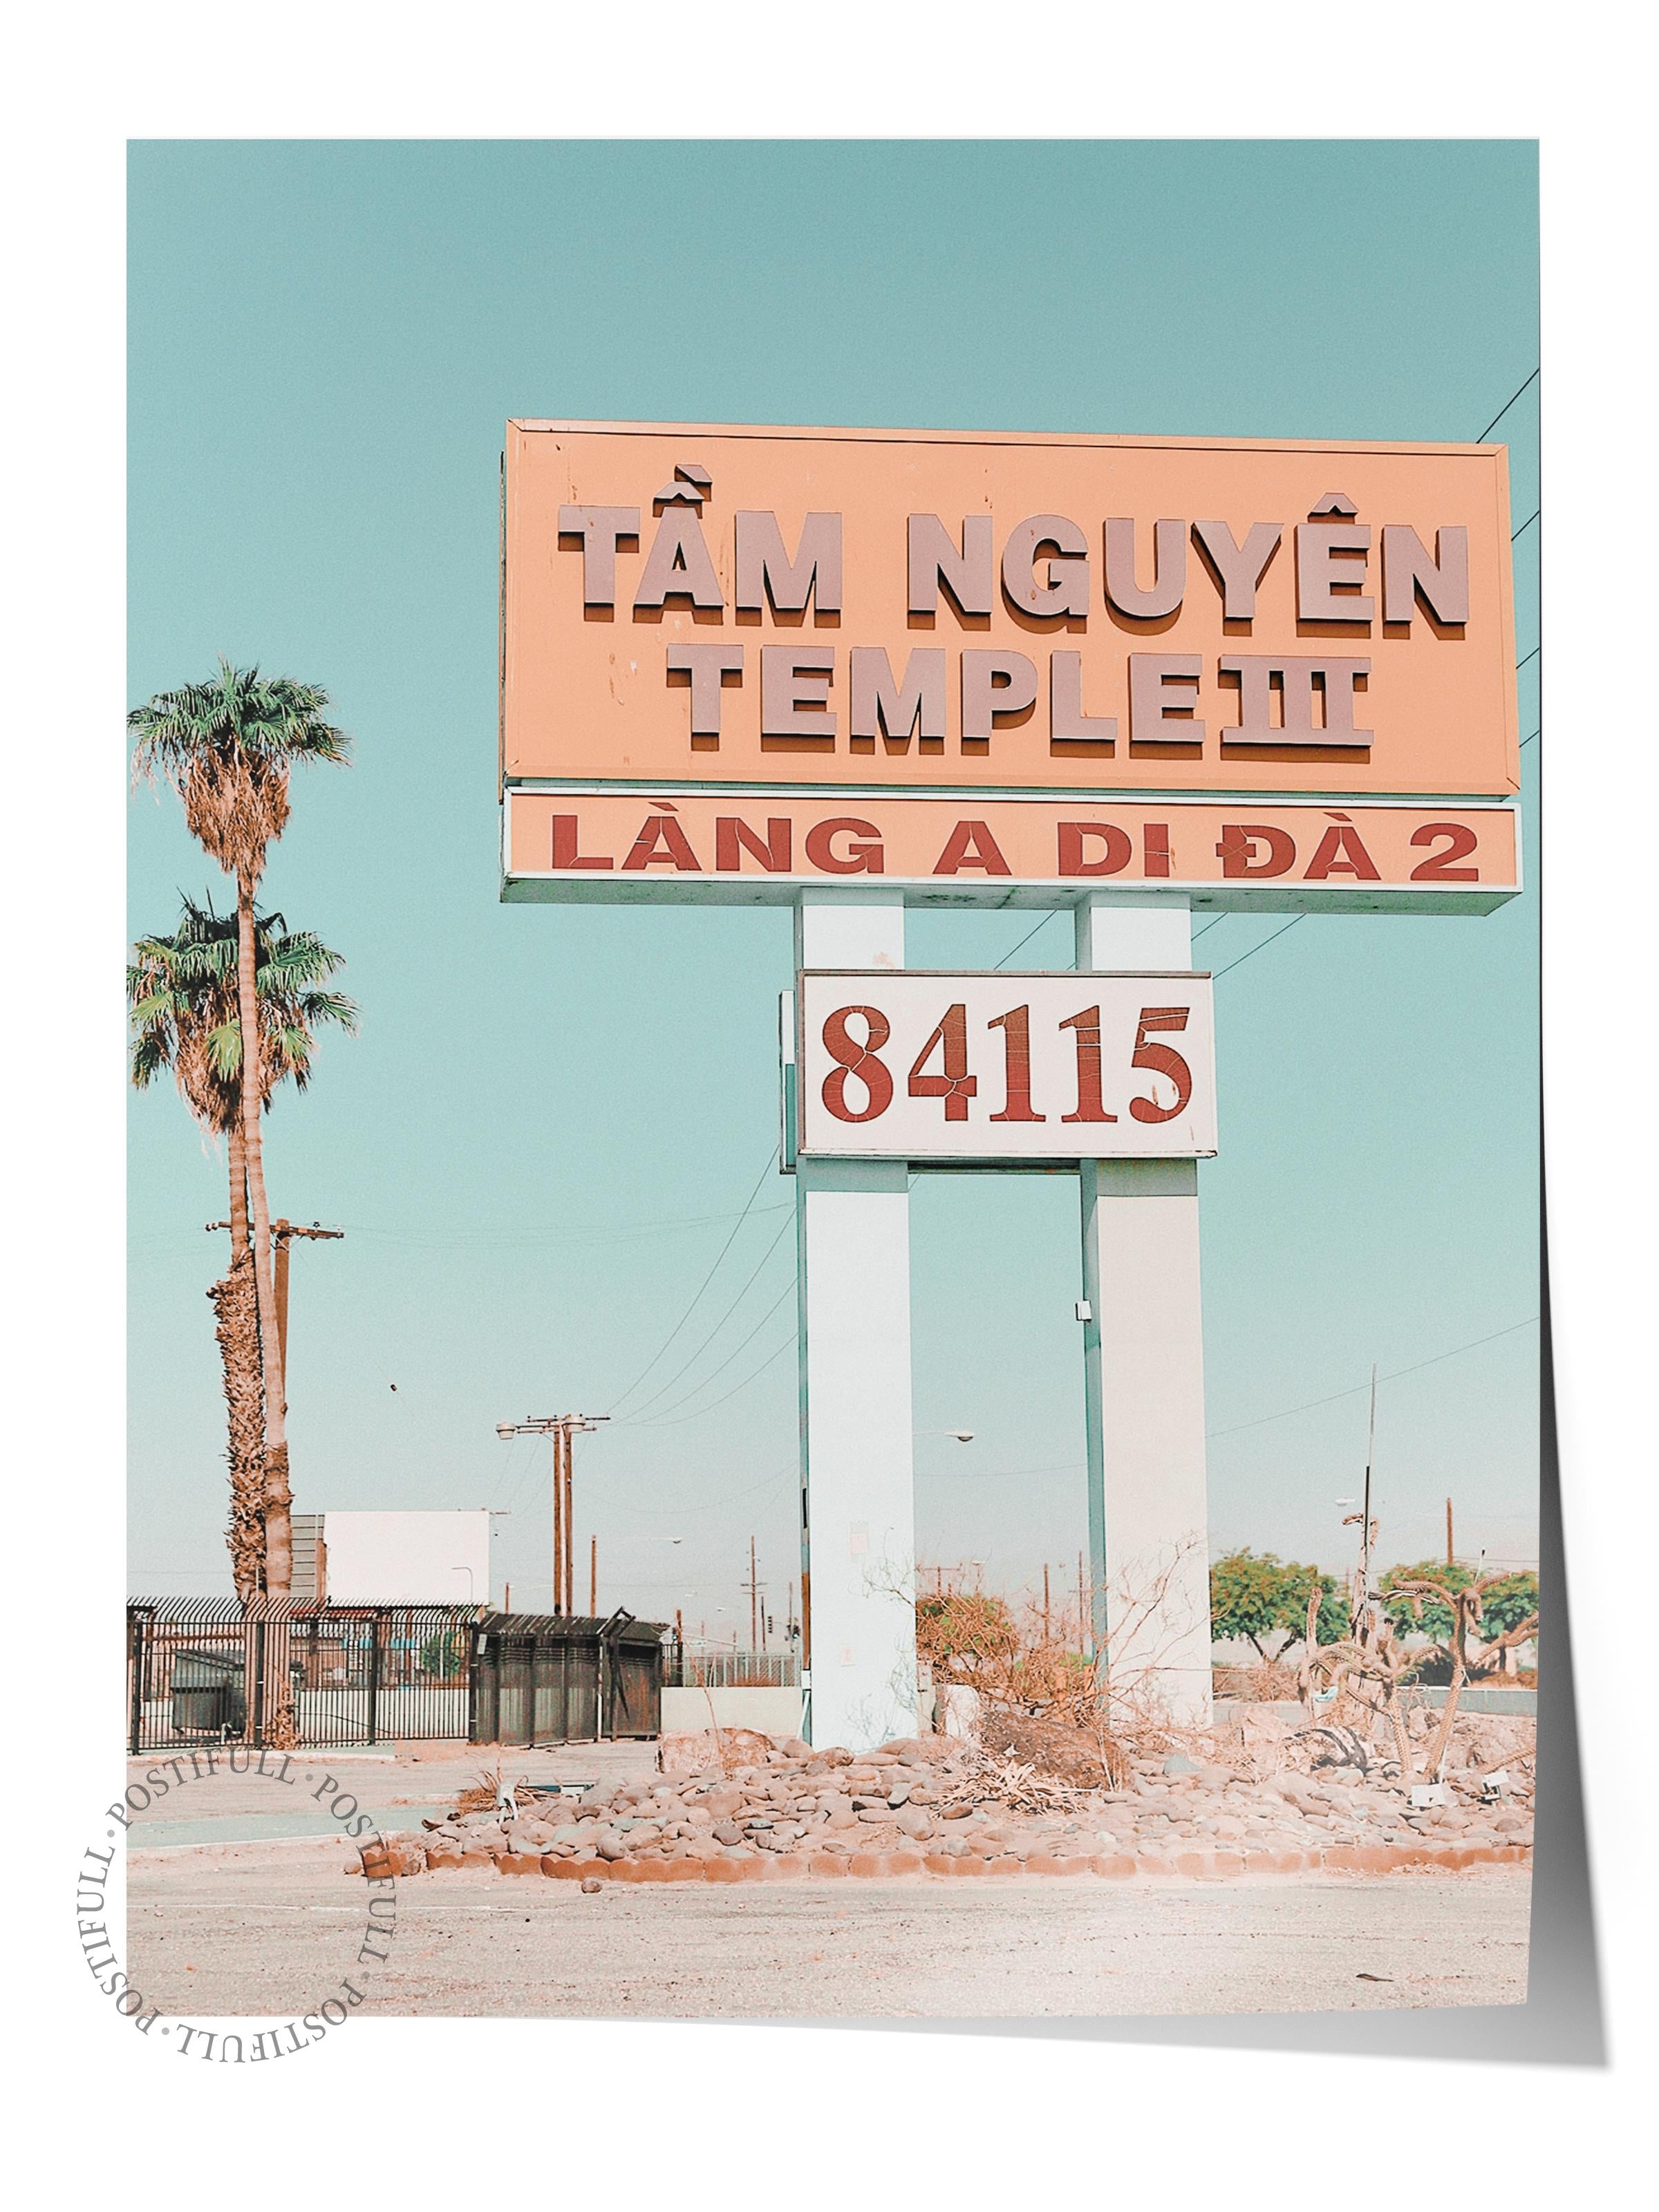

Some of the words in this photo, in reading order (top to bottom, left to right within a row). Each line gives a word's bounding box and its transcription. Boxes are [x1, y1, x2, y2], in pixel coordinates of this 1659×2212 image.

[907, 492, 1470, 639] NGUYÊN
[667, 644, 1205, 760] TEMPLE
[551, 802, 885, 875] LÀNG
[932, 821, 1013, 877] A
[1056, 822, 1170, 878] DI
[1215, 812, 1382, 881] ĐÀ
[1409, 823, 1479, 882] 2
[821, 1003, 1192, 1124] 84115
